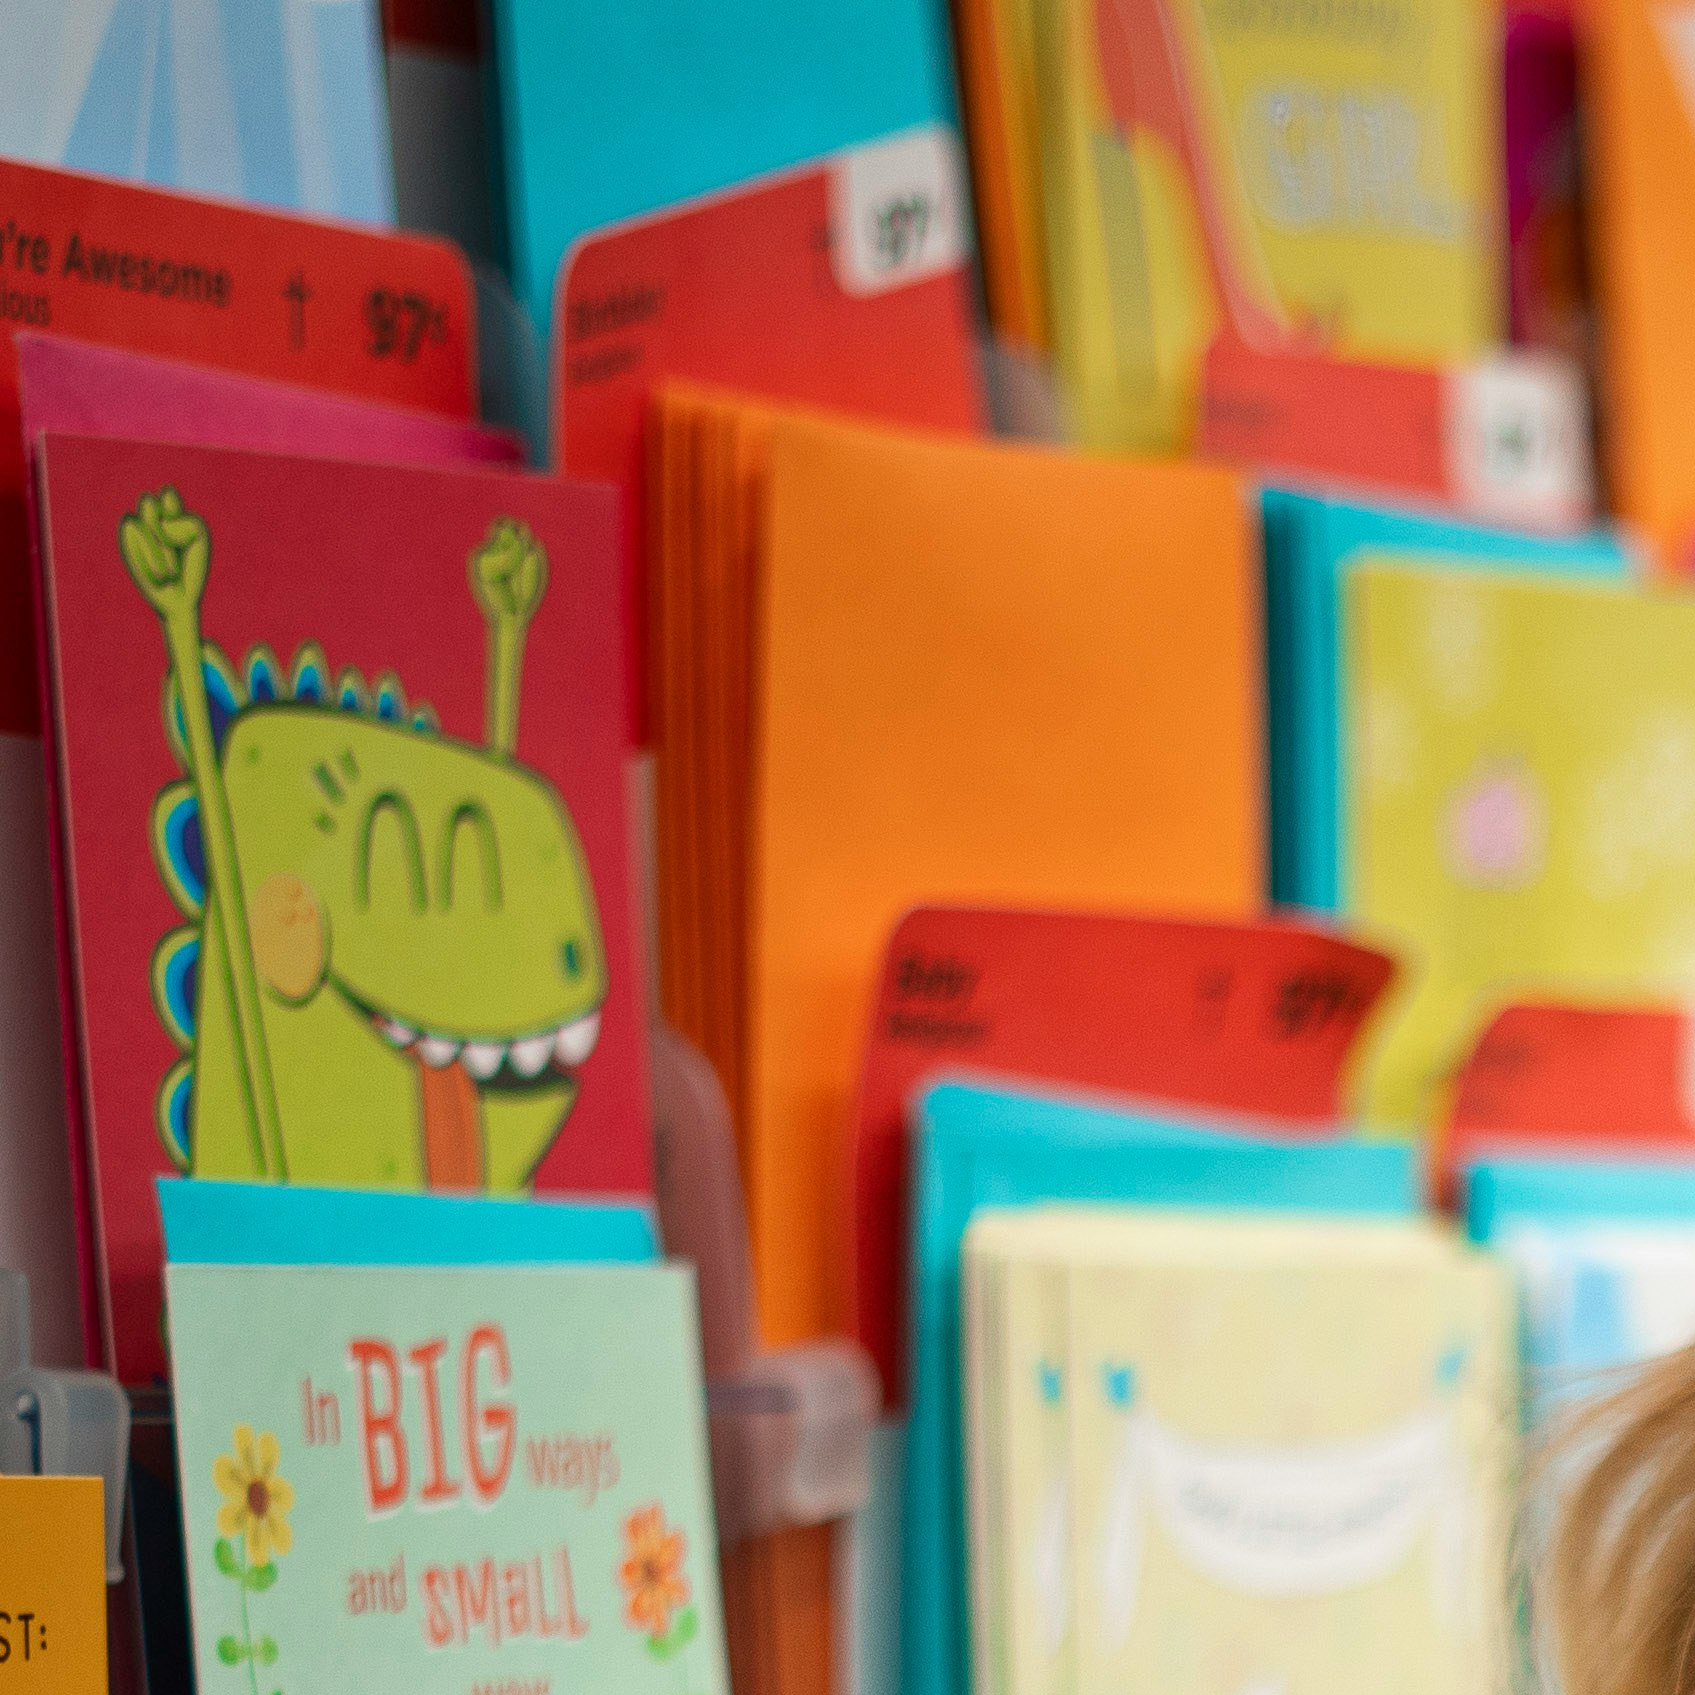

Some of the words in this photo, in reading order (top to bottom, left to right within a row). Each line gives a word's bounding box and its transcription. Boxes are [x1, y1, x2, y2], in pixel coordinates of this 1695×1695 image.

[62, 233, 231, 307] Awesome
[303, 1376, 341, 1445] In
[349, 1322, 516, 1512] BIG
[526, 1432, 620, 1507] ways
[345, 1550, 407, 1616] and
